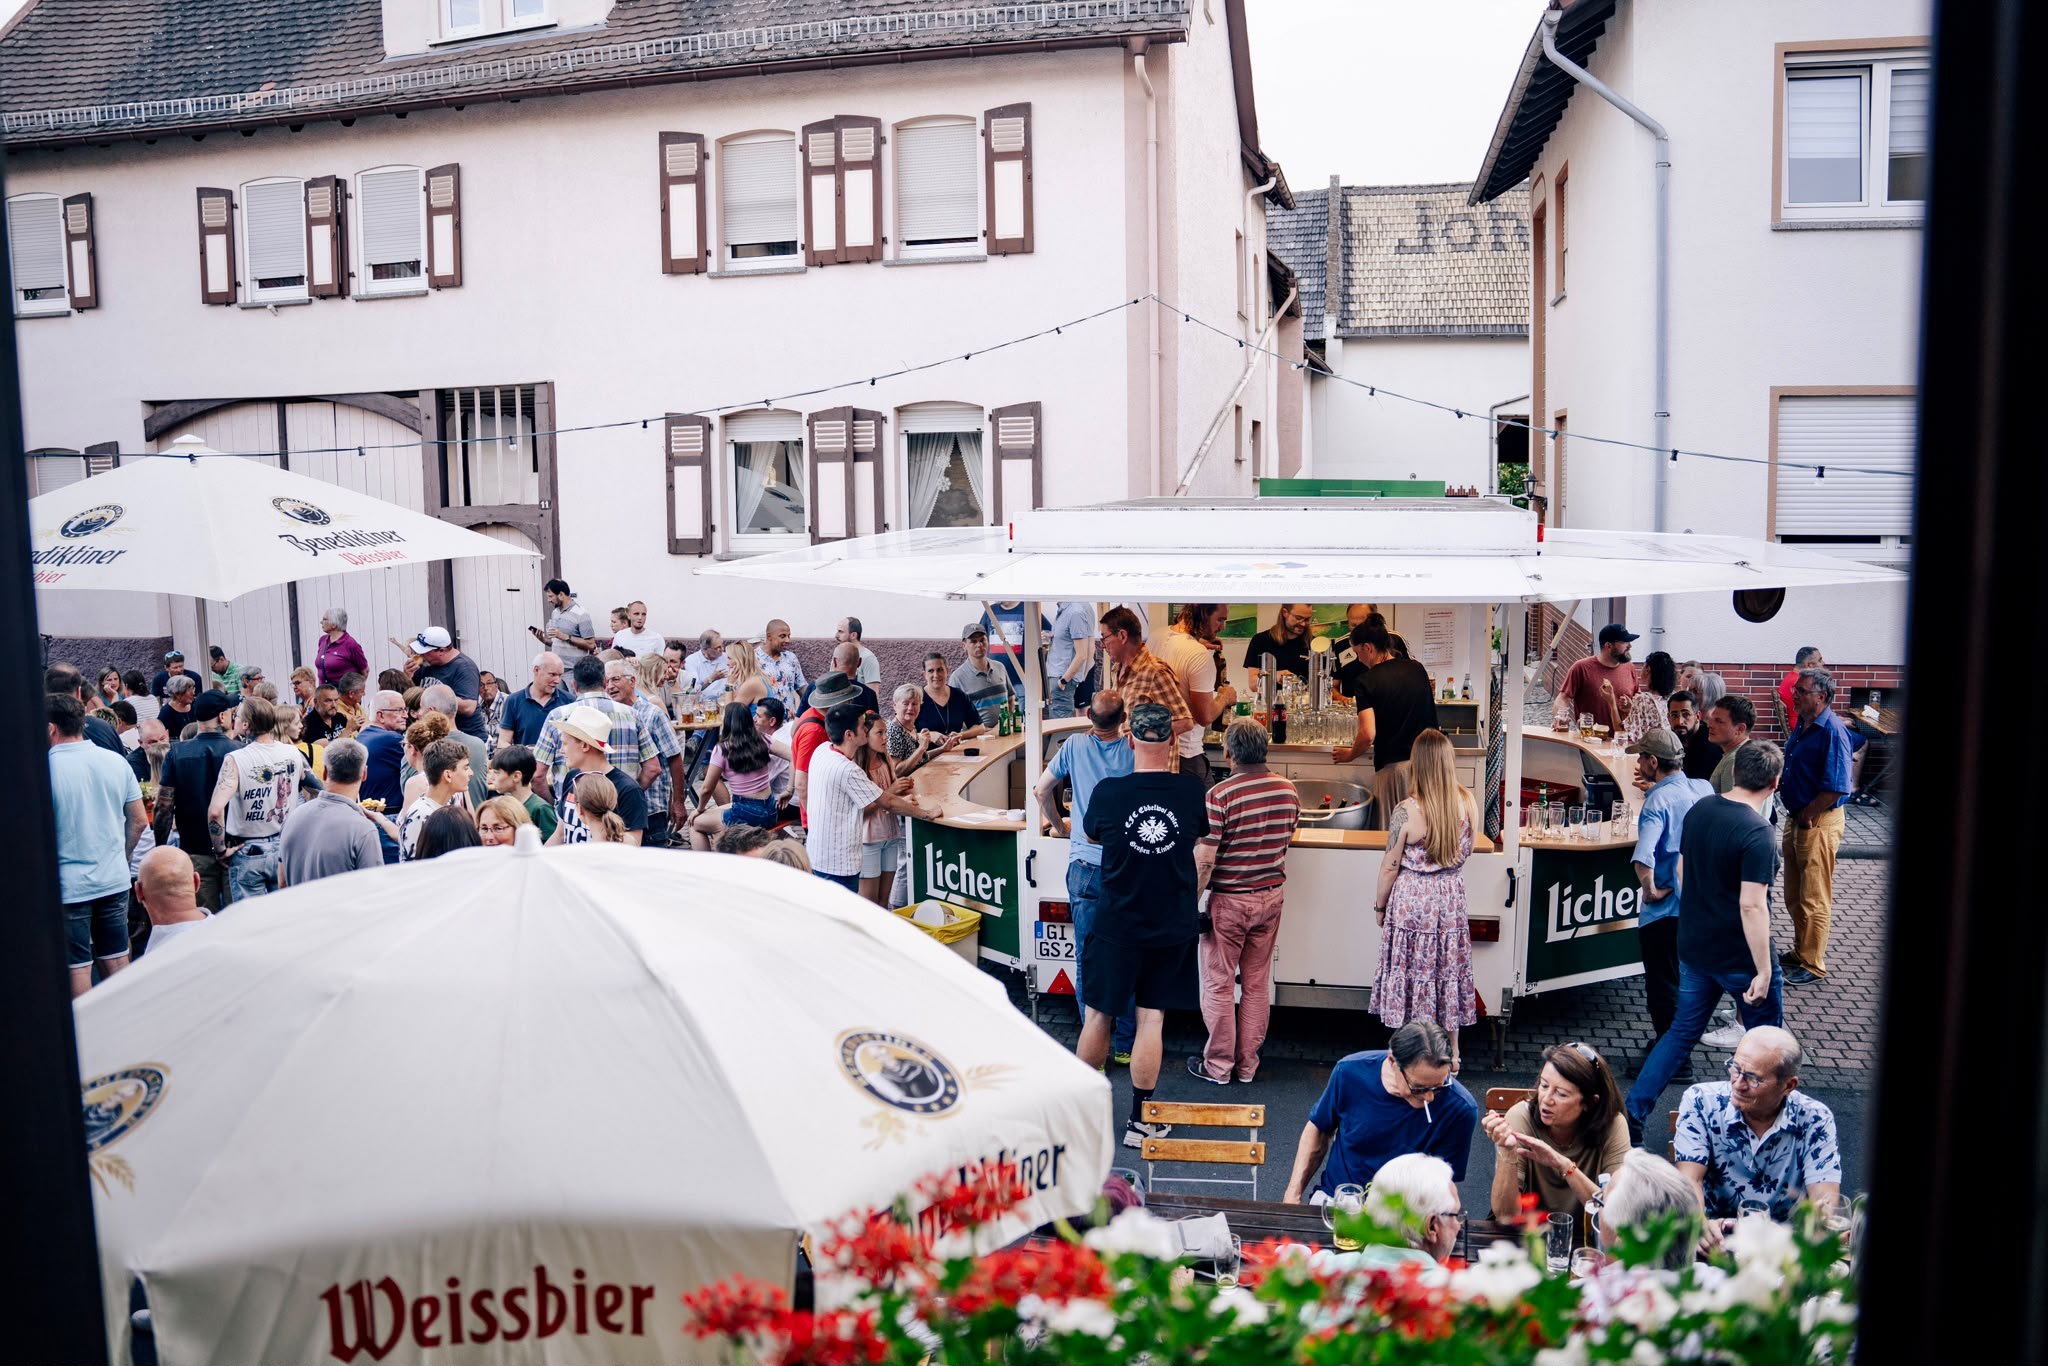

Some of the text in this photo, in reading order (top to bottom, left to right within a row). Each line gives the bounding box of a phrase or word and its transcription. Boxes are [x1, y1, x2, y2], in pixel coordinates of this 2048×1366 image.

[540, 500, 549, 509] 11
[278, 529, 407, 557] Benediktiner
[32, 545, 127, 567] ediktiner
[338, 549, 408, 566] Weissbier
[243, 787, 272, 800] HEAVY
[251, 800, 264, 810] AS
[245, 811, 265, 821] HELL
[924, 842, 1007, 905] Licher
[1046, 924, 1067, 940] GI
[1040, 942, 1076, 958] GS 2
[319, 1264, 655, 1364] Weissbier
